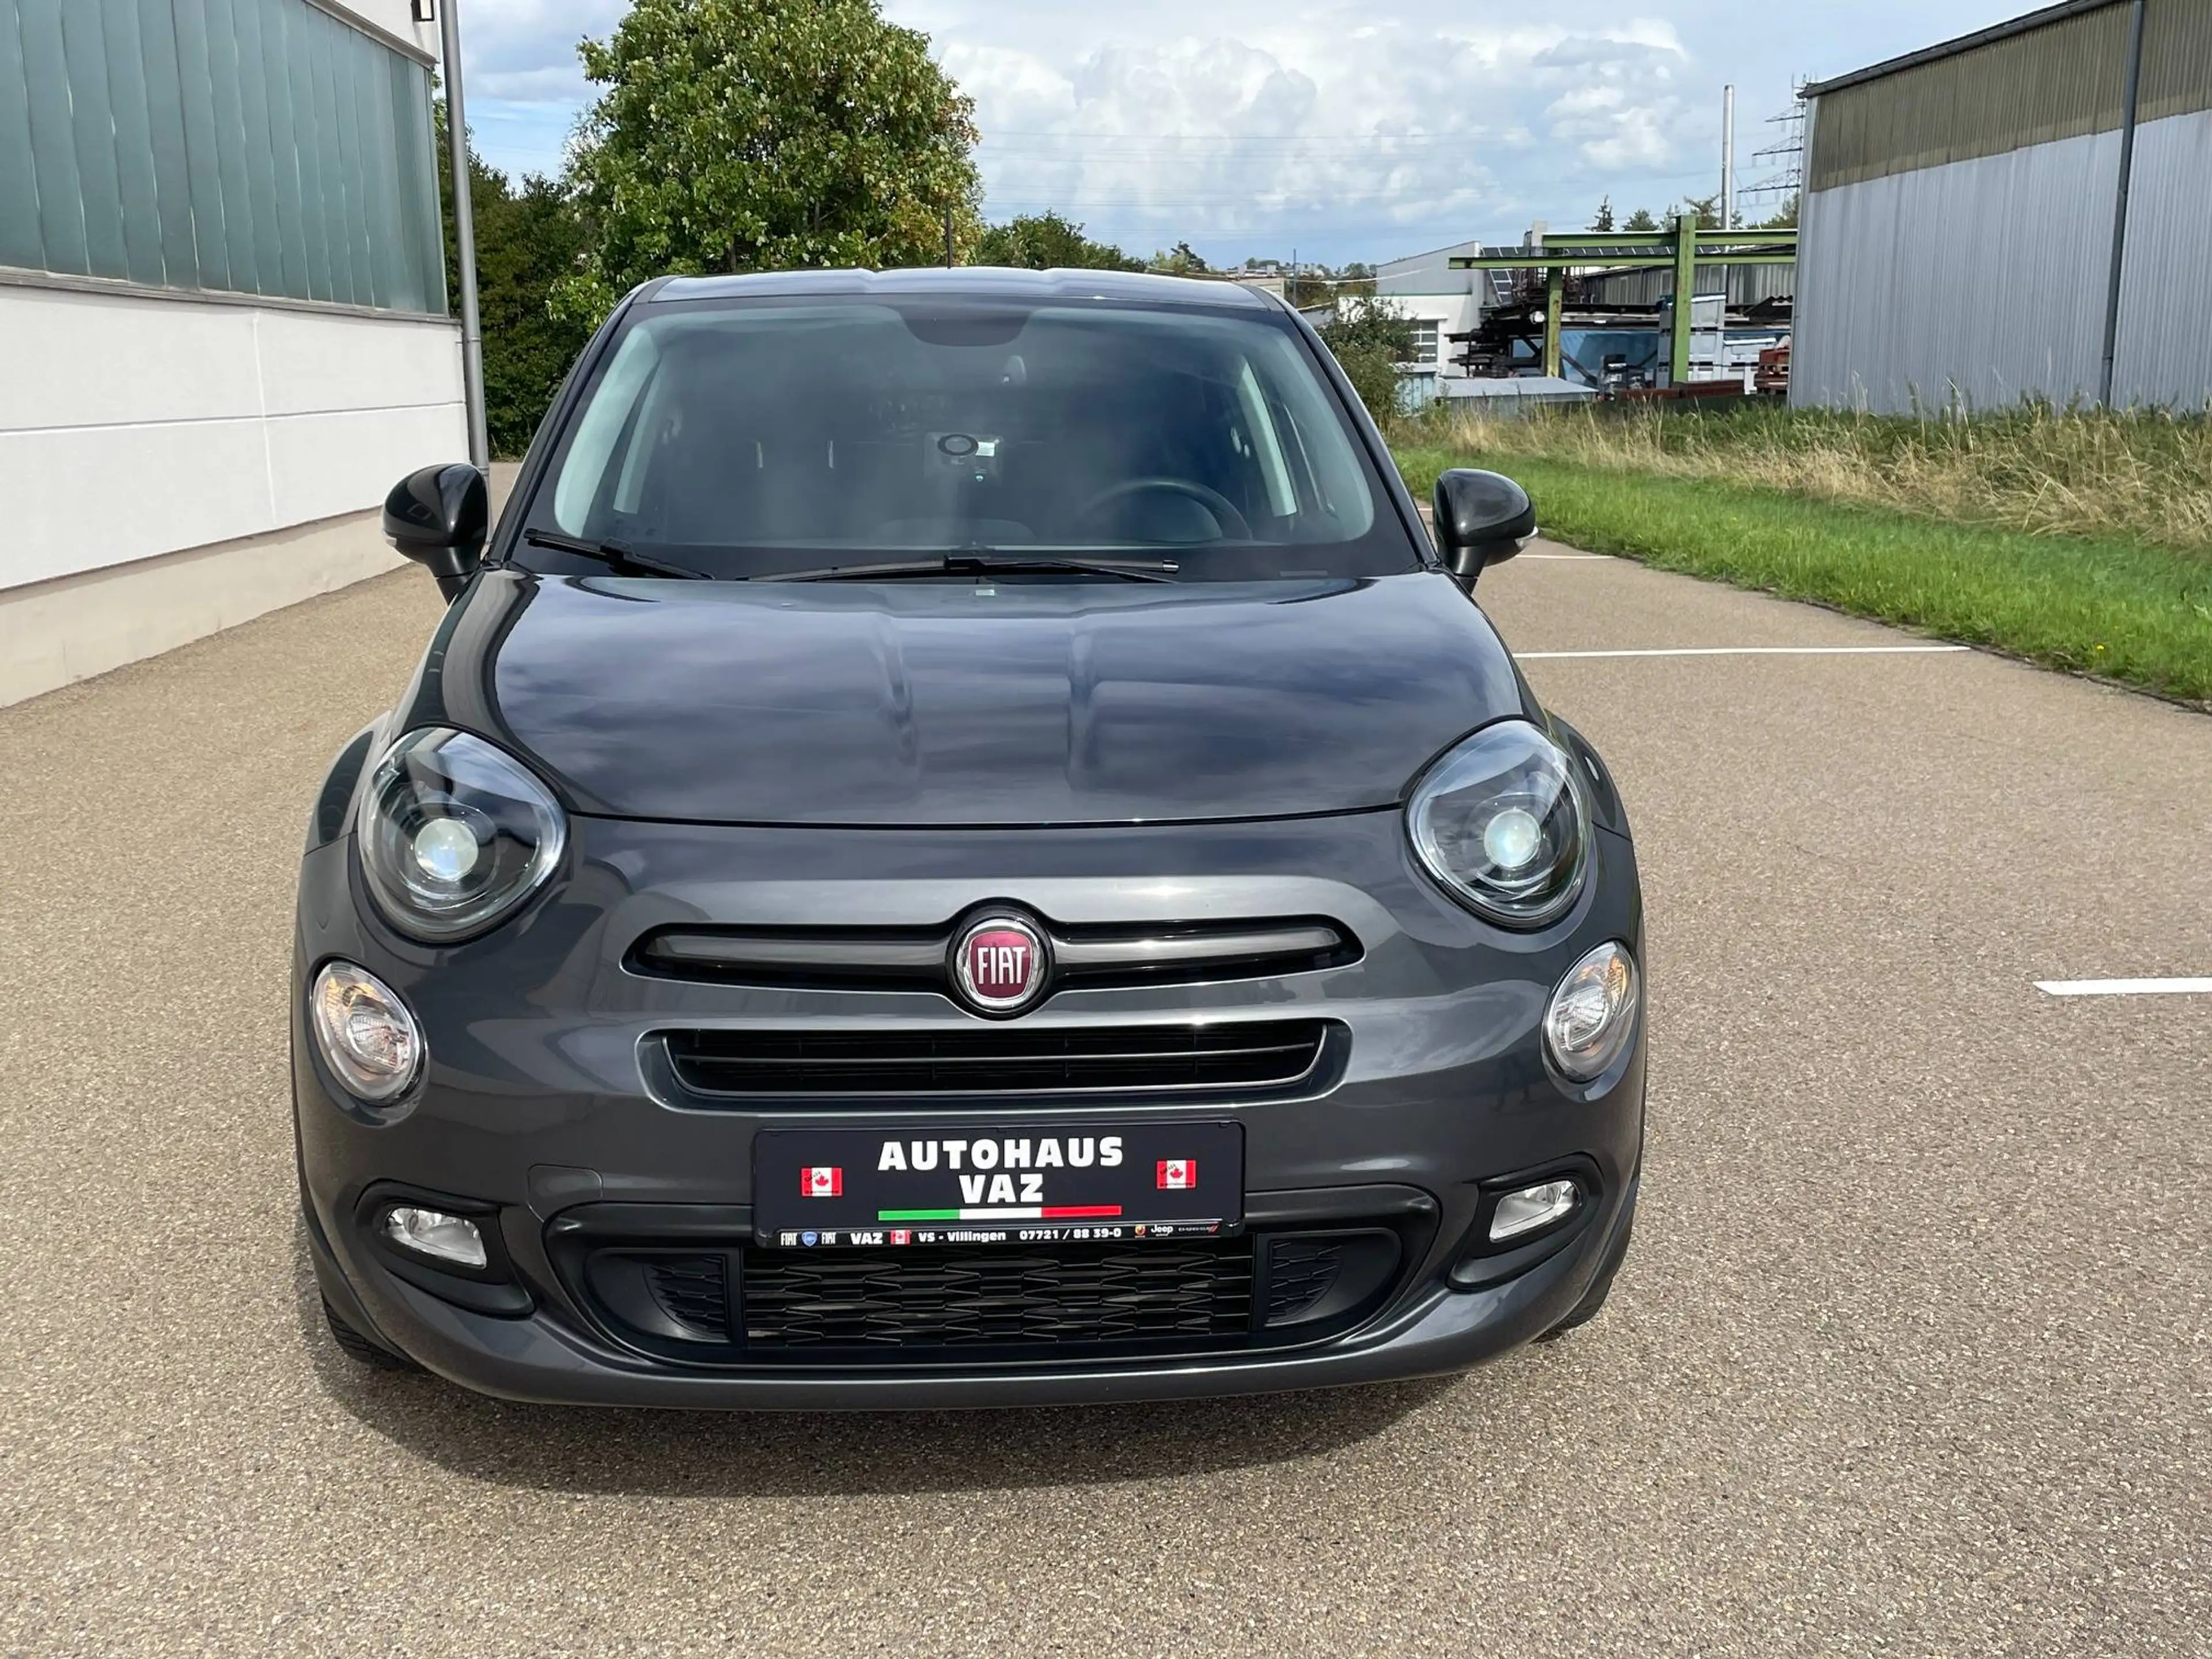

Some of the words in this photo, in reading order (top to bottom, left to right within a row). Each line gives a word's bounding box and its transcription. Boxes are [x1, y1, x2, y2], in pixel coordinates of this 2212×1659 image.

[976, 946, 1027, 985] FIAT
[877, 1136, 1123, 1171] AUTOHAUS
[959, 1173, 1043, 1204] VAZ
[850, 1232, 883, 1245] VAZ
[918, 1232, 935, 1243] VS
[946, 1230, 1006, 1243] Villingen
[1019, 1230, 1059, 1240] 07721
[1062, 1229, 1070, 1240] /
[1093, 1228, 1122, 1238] 39-0
[1150, 1224, 1174, 1235] Jeep
[781, 1232, 798, 1246] FIAT
[821, 1232, 837, 1245] FIAT
